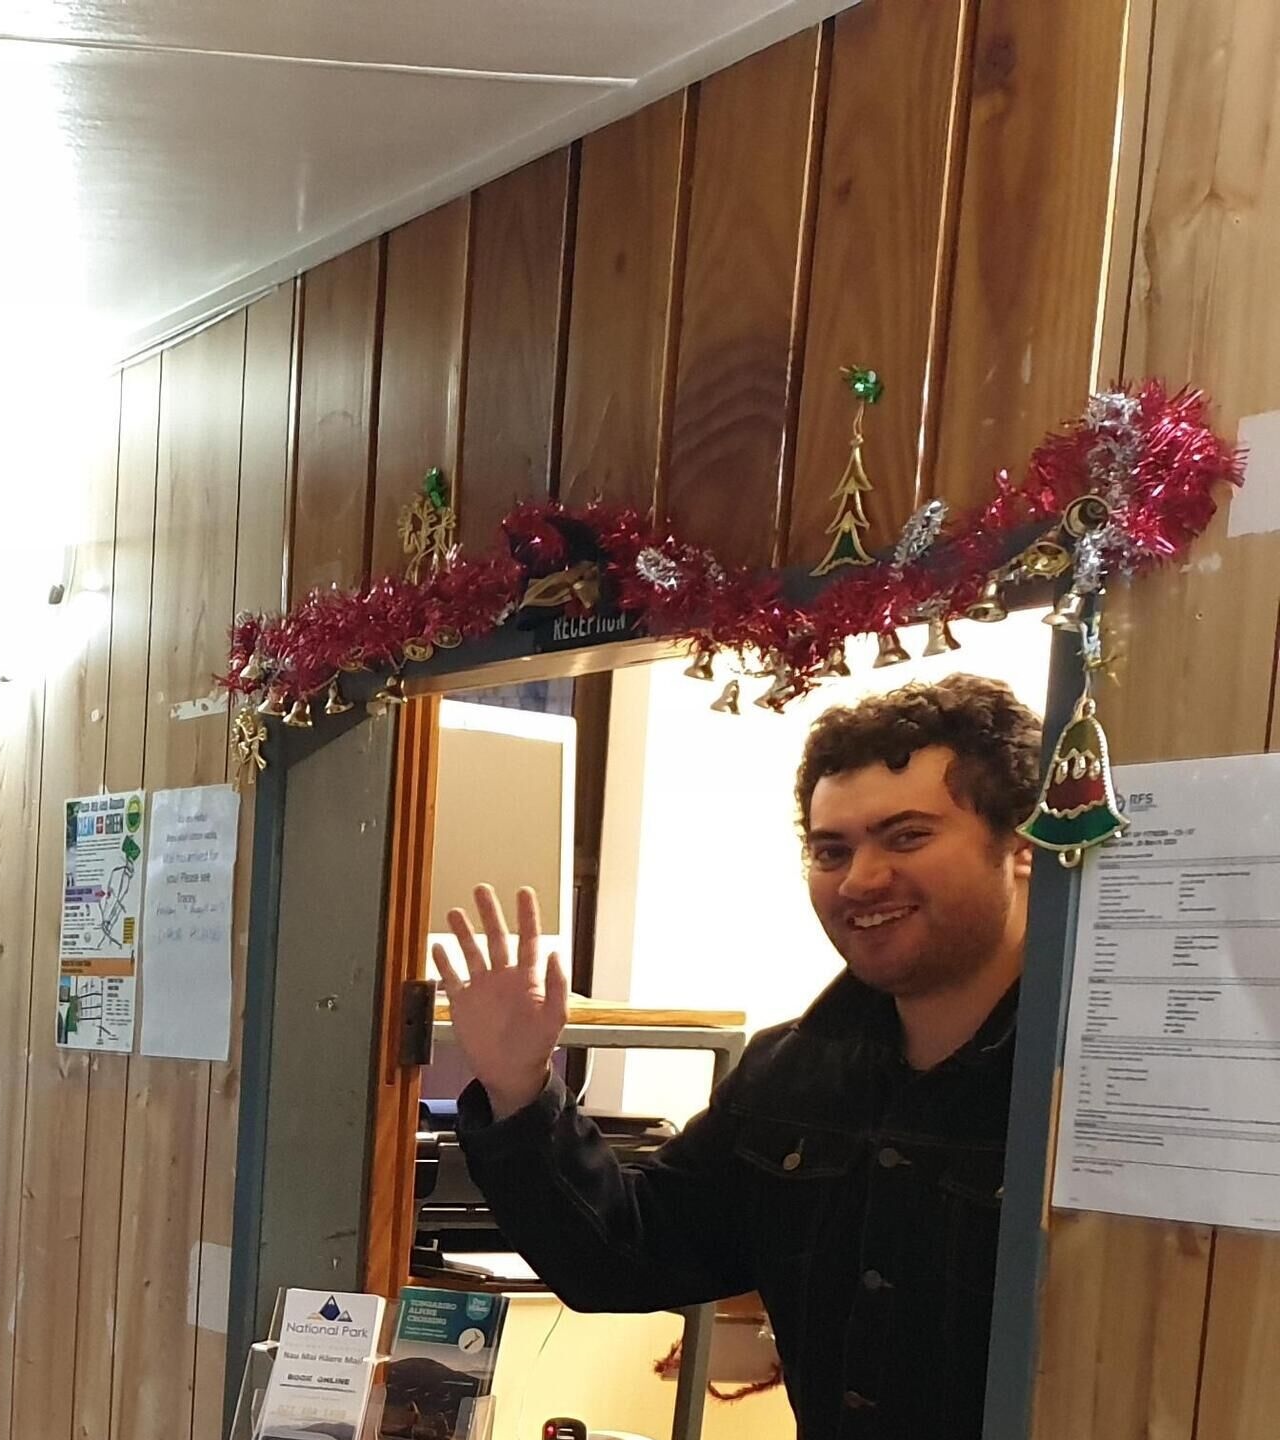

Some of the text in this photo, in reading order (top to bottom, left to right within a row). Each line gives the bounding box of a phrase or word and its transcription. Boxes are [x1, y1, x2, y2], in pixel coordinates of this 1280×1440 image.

[286, 1322, 369, 1339] National Park
[316, 1375, 351, 1386] ONLINE
